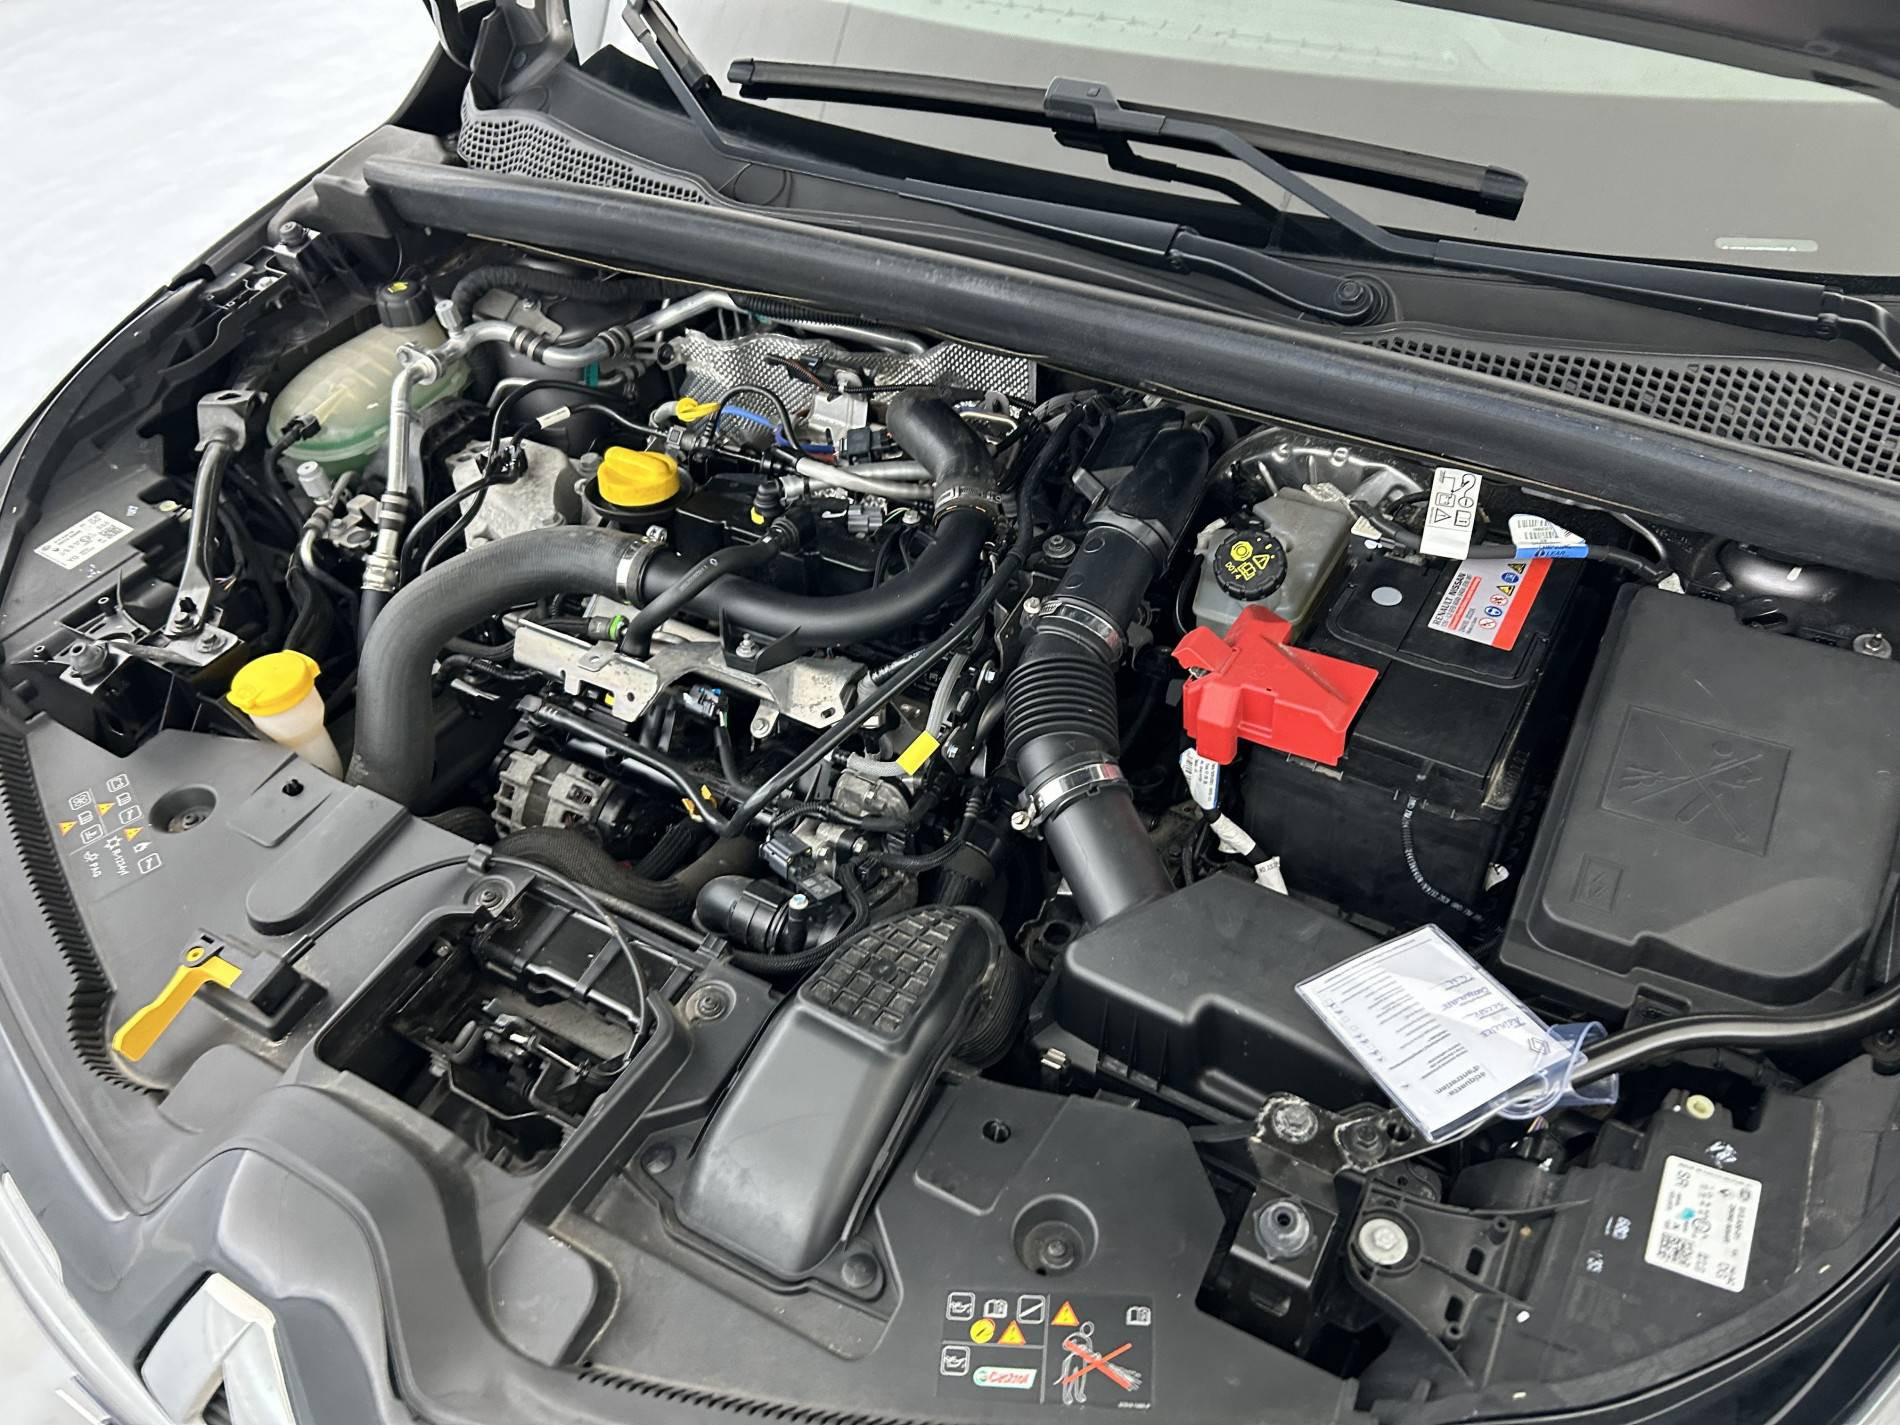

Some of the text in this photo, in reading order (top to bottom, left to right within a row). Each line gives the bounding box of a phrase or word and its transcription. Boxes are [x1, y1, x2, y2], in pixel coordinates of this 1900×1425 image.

[1225, 561, 1239, 574] DOT
[1432, 597, 1453, 625] RENAULT
[1448, 572, 1466, 597] NISSAN
